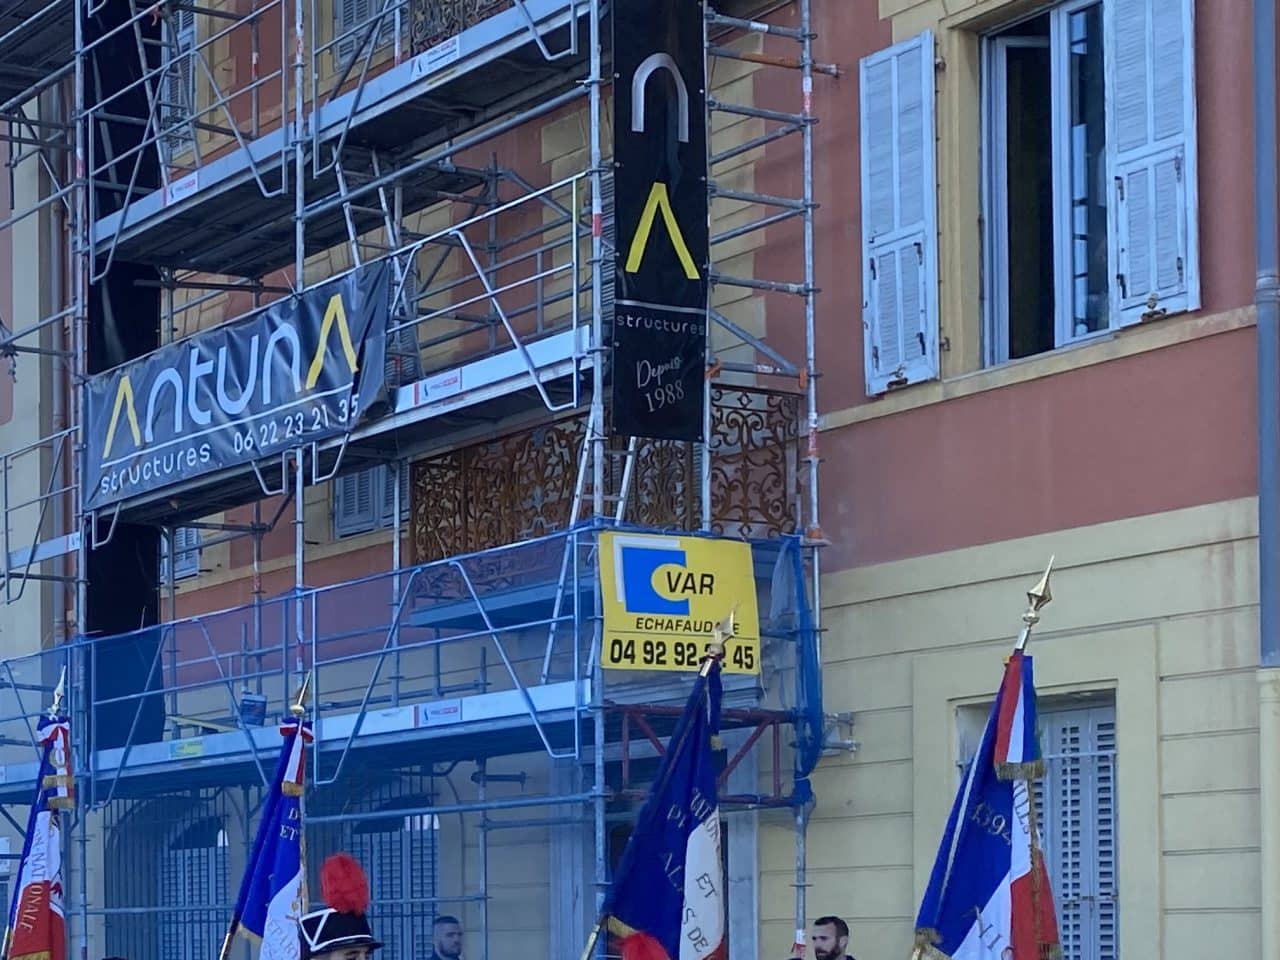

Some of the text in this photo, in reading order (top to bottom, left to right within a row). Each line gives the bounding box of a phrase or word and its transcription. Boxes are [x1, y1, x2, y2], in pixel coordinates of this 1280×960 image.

[616, 315, 704, 336] structures
[636, 356, 682, 389] Depuis
[645, 379, 685, 413] 1988
[233, 393, 360, 454] 06 22 23 21 35
[101, 443, 211, 494] structures
[666, 571, 715, 596] VAR
[636, 617, 741, 635] ECHAFAUDE
[610, 638, 635, 665] 04
[643, 639, 667, 666] 92
[674, 642, 697, 667] 92
[733, 645, 754, 670] 45
[687, 926, 708, 953] DE
